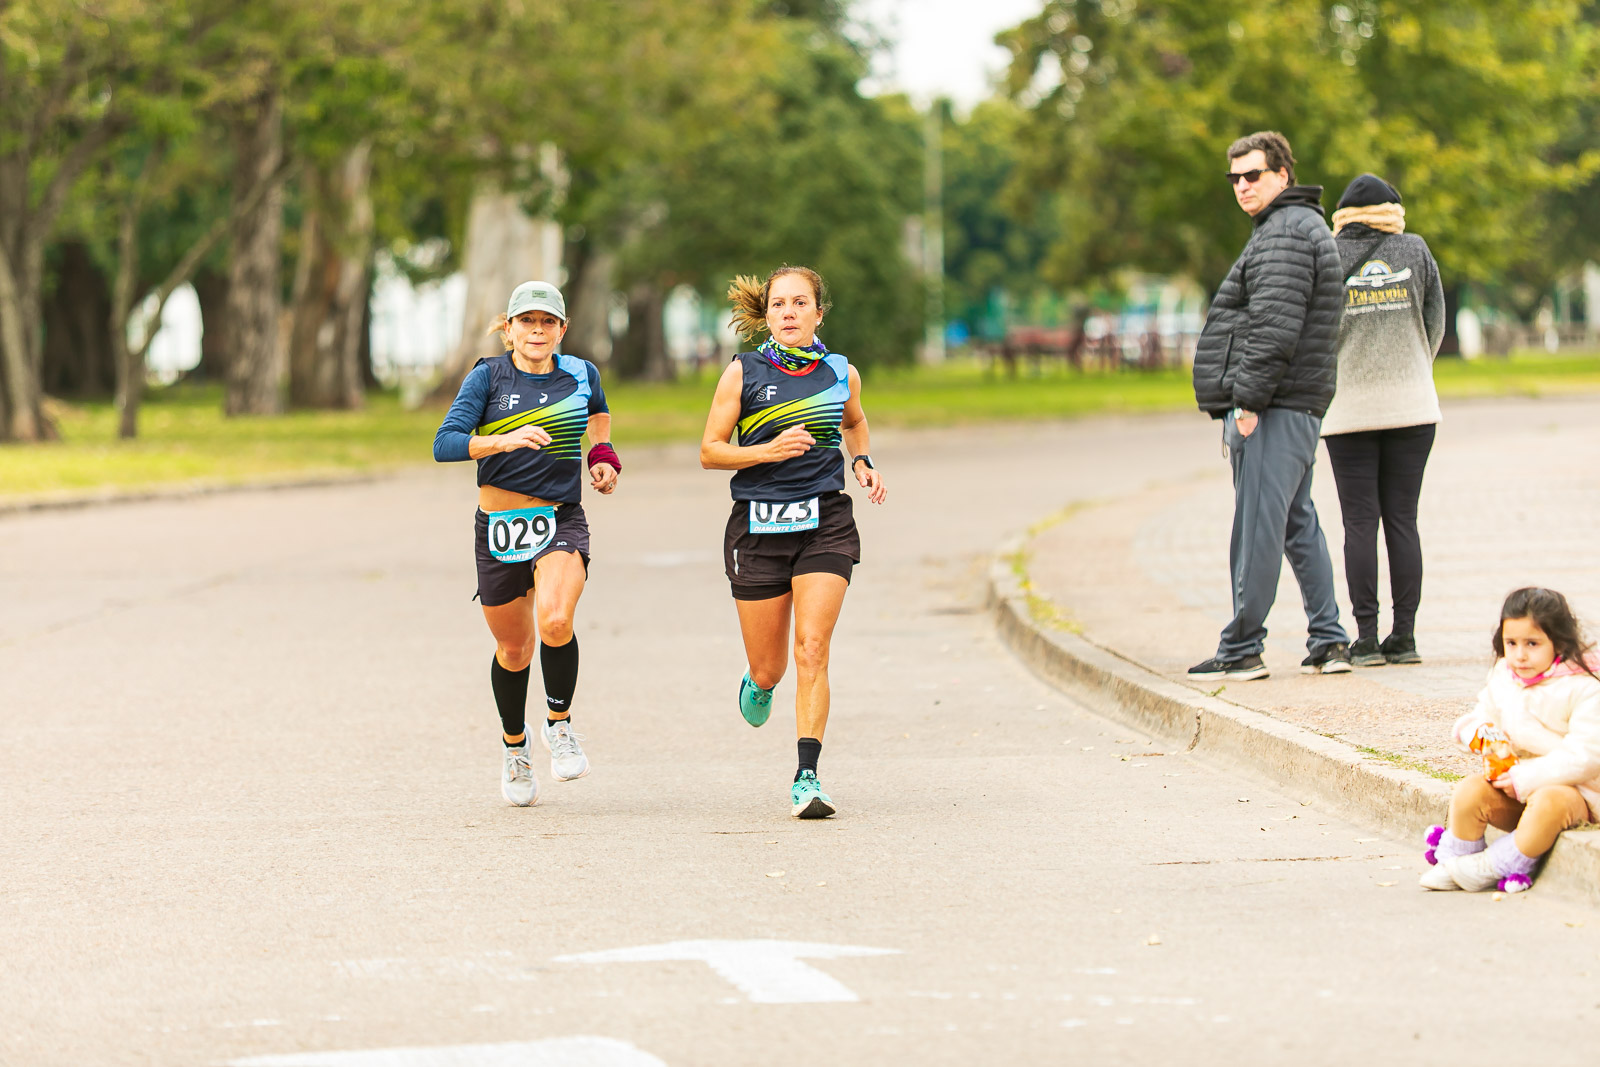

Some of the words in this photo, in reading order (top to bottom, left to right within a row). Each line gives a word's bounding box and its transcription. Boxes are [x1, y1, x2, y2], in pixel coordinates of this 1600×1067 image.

[756, 385, 778, 401] SF
[499, 394, 520, 410] SF
[493, 515, 550, 552] 029
[791, 522, 815, 531] CORRE
